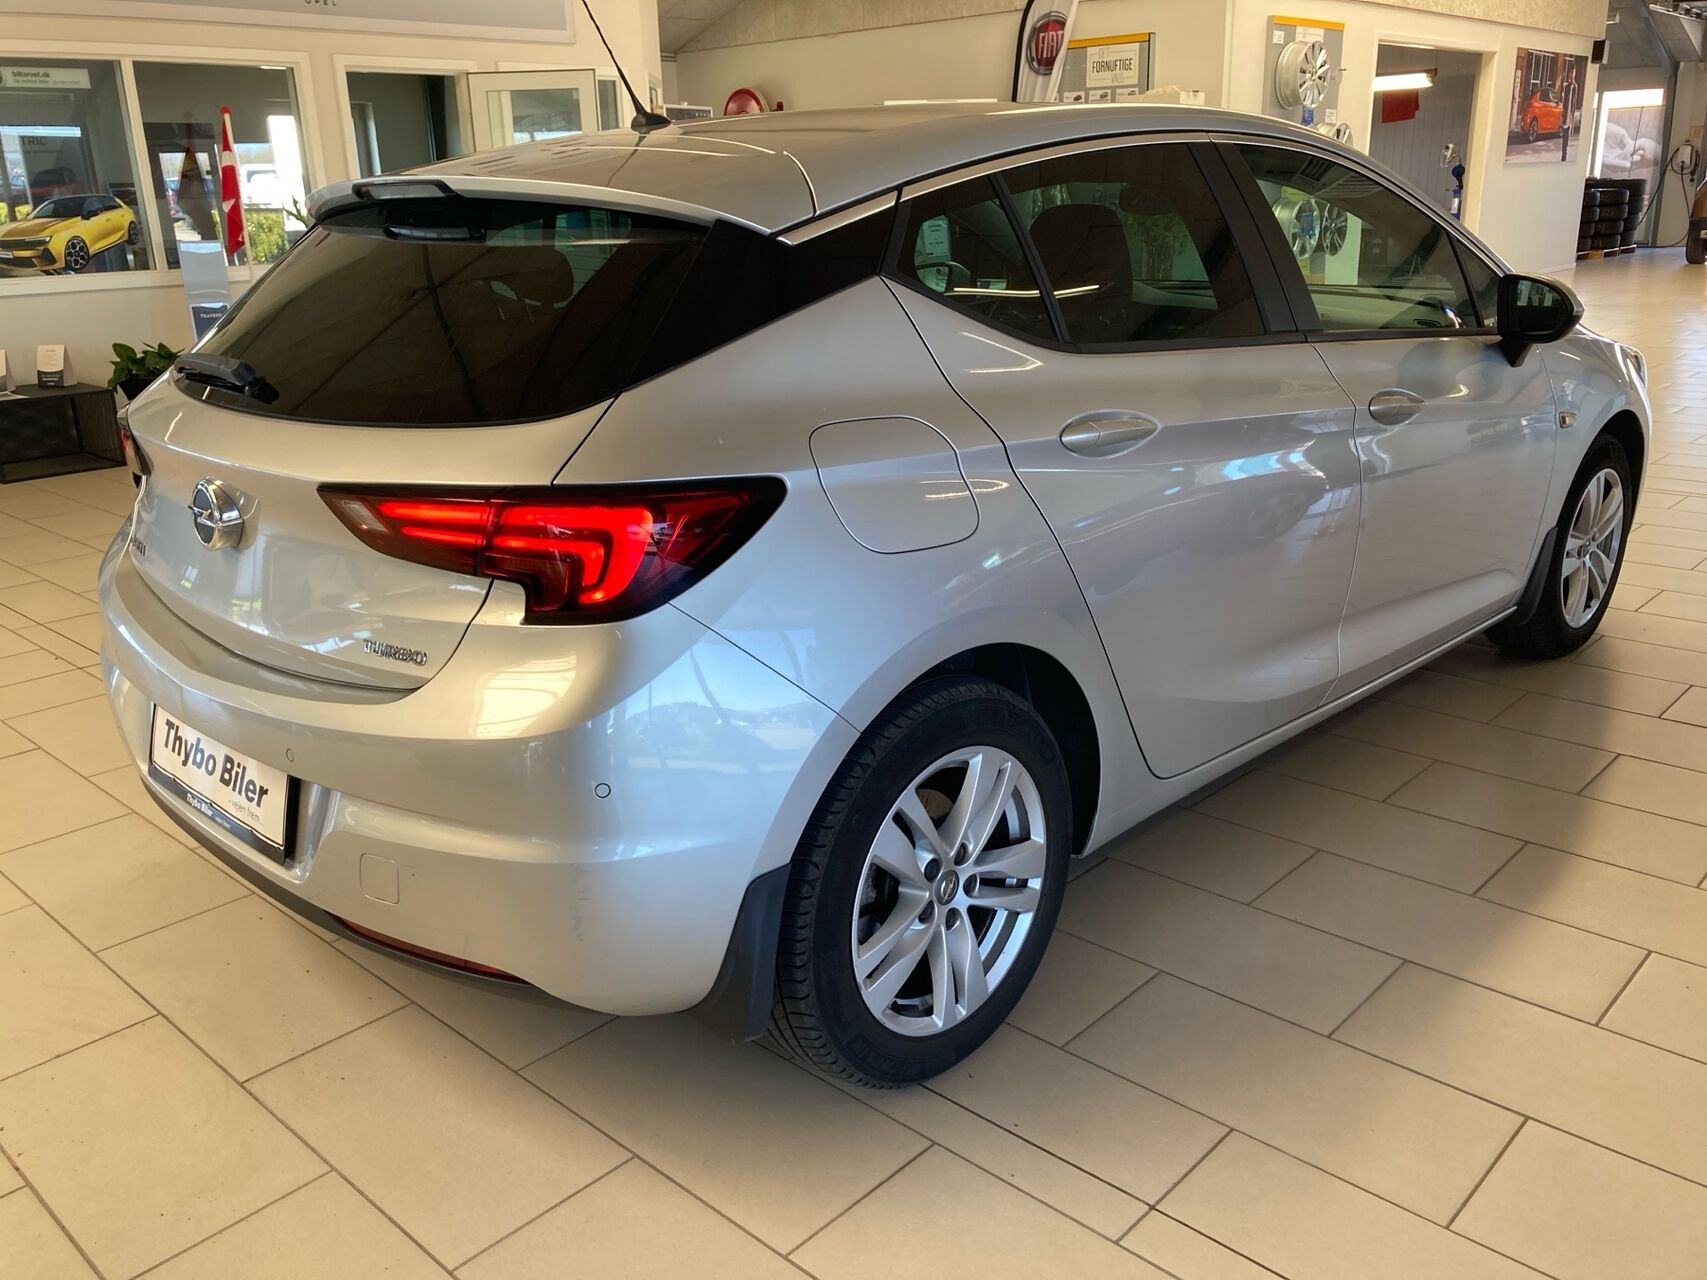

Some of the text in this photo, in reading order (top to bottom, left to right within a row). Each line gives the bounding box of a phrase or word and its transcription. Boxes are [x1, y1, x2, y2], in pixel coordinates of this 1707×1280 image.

[1038, 31, 1064, 58] FIAT
[1092, 57, 1133, 73] FORNUFTIGE
[363, 639, 428, 667] TURBO
[164, 718, 269, 808] Thybo Biler
